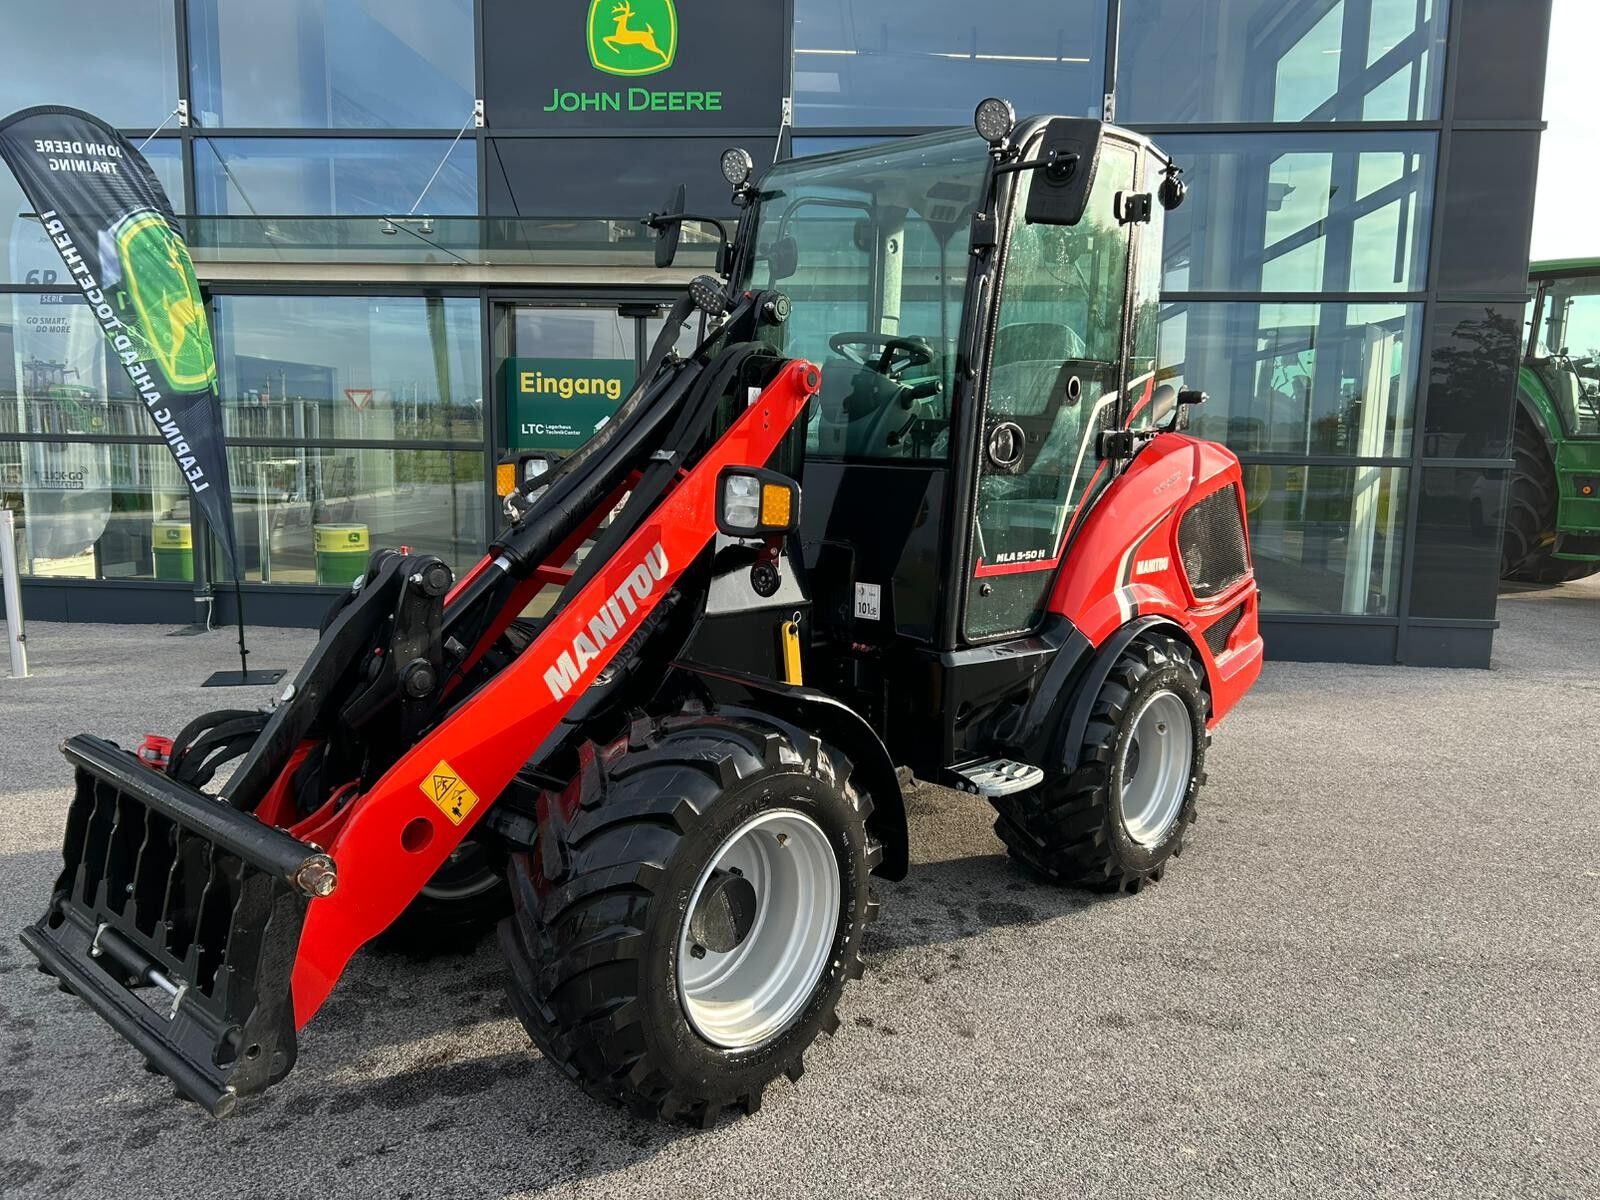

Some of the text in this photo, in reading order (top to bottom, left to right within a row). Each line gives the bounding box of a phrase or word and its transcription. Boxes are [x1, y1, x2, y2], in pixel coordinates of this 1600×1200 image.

[543, 87, 722, 112] JOHN DEERE
[41, 295, 64, 303] SERIE
[26, 317, 39, 325] GO
[36, 325, 71, 333] DO MORE
[520, 371, 621, 400] Eingang
[521, 423, 544, 434] LTC
[996, 552, 1016, 563] MLA
[1038, 549, 1046, 559] H
[1135, 556, 1169, 575] MANITOU
[543, 541, 669, 703] MANITOU
